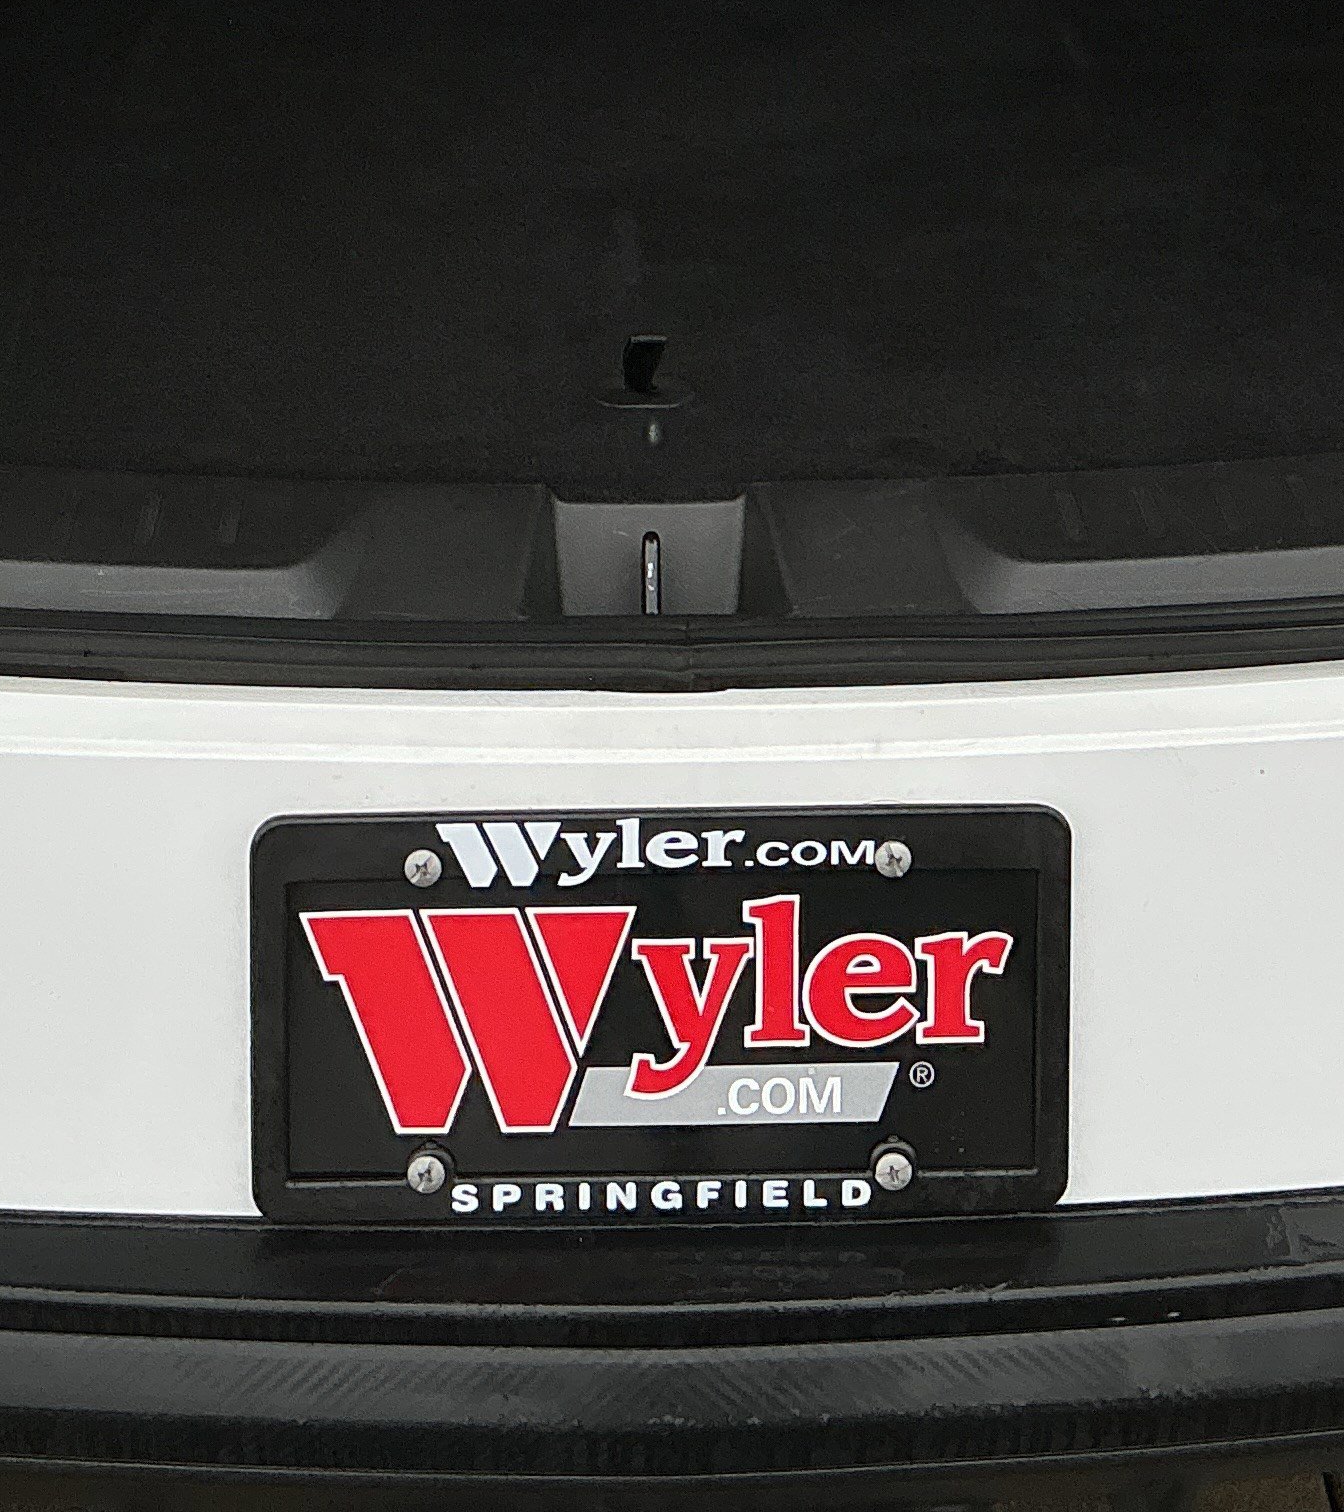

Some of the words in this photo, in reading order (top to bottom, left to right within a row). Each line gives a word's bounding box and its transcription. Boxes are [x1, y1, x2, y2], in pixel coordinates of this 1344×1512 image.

[299, 894, 1013, 1134] Wyler
[717, 1076, 842, 1115] .COM
[451, 1179, 872, 1213] SPRINGFIELD
